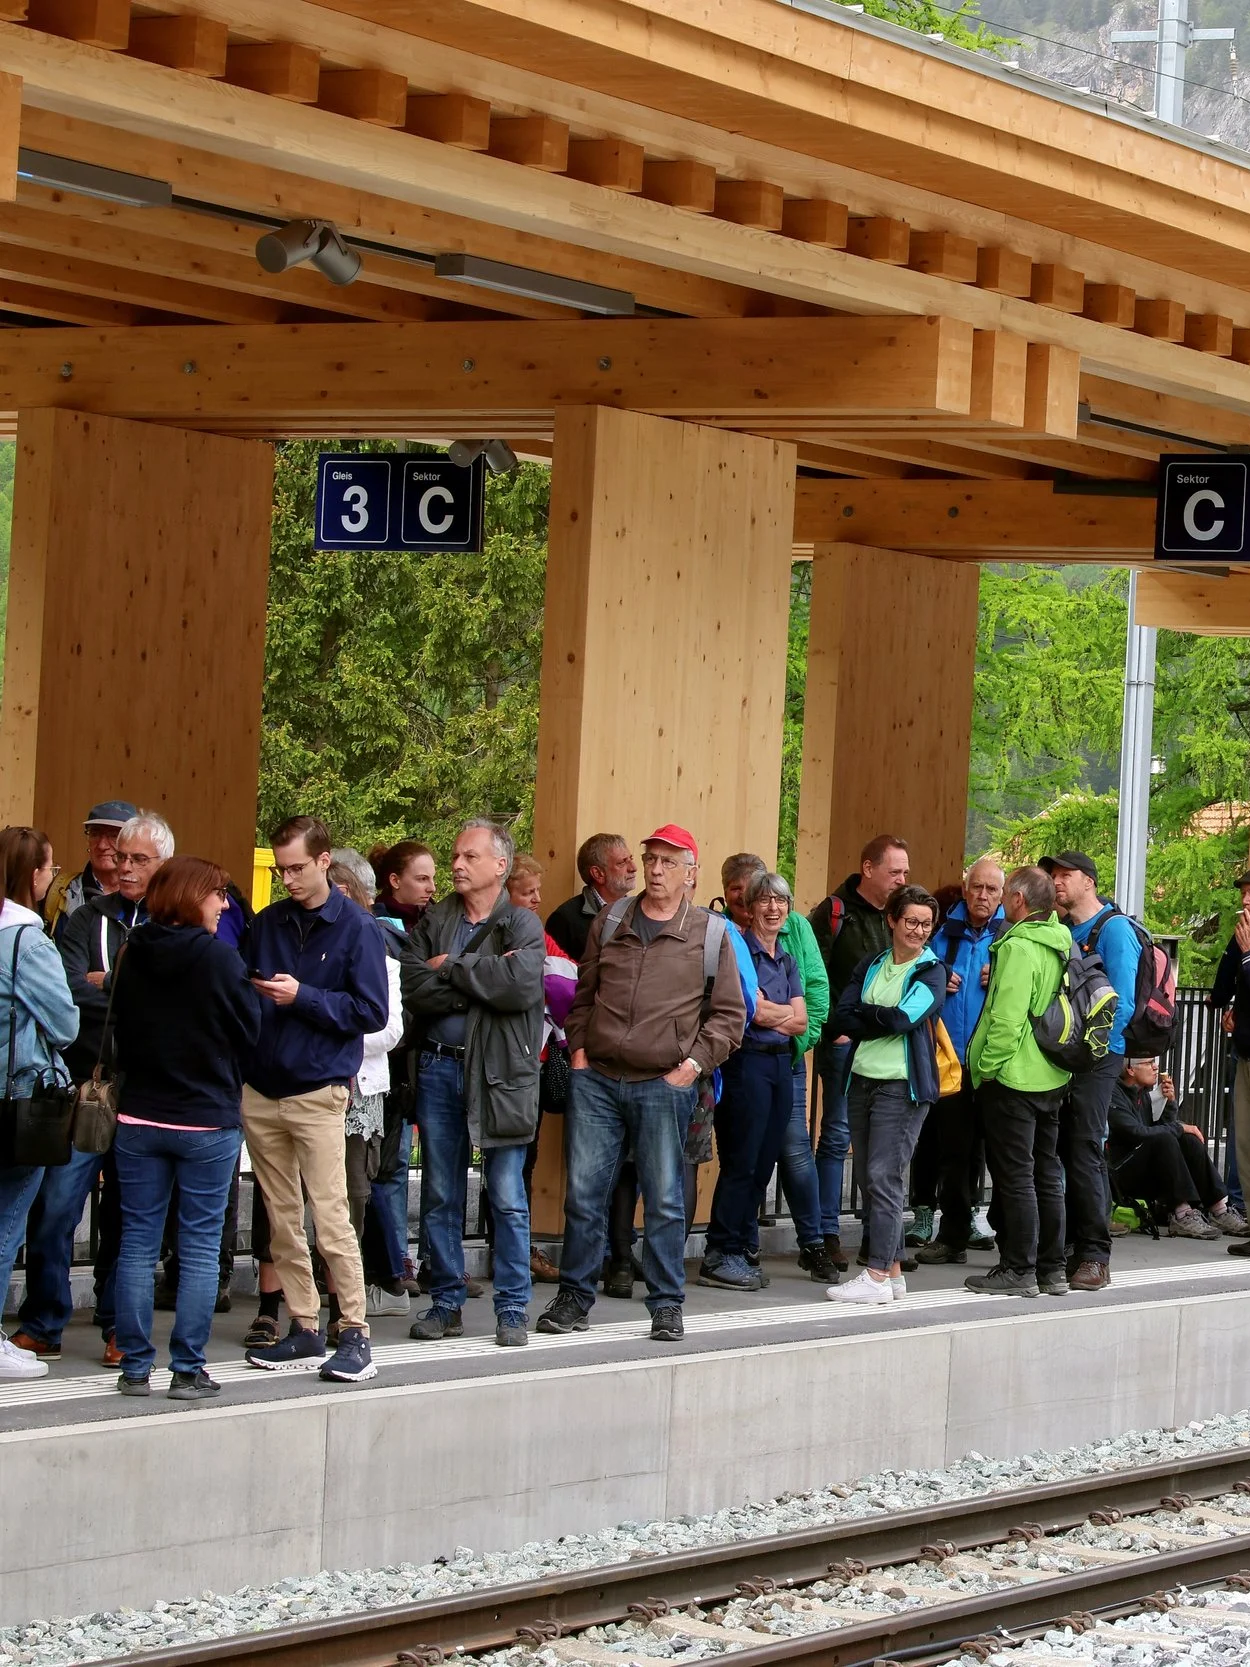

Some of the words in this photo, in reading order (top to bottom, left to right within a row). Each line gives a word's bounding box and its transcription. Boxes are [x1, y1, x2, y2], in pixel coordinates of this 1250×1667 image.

[332, 471, 353, 481] Gleis
[412, 472, 441, 481] Sektor
[1176, 474, 1210, 484] Sektor
[341, 485, 369, 533] 3
[418, 486, 455, 534] C
[1183, 489, 1225, 541] C
